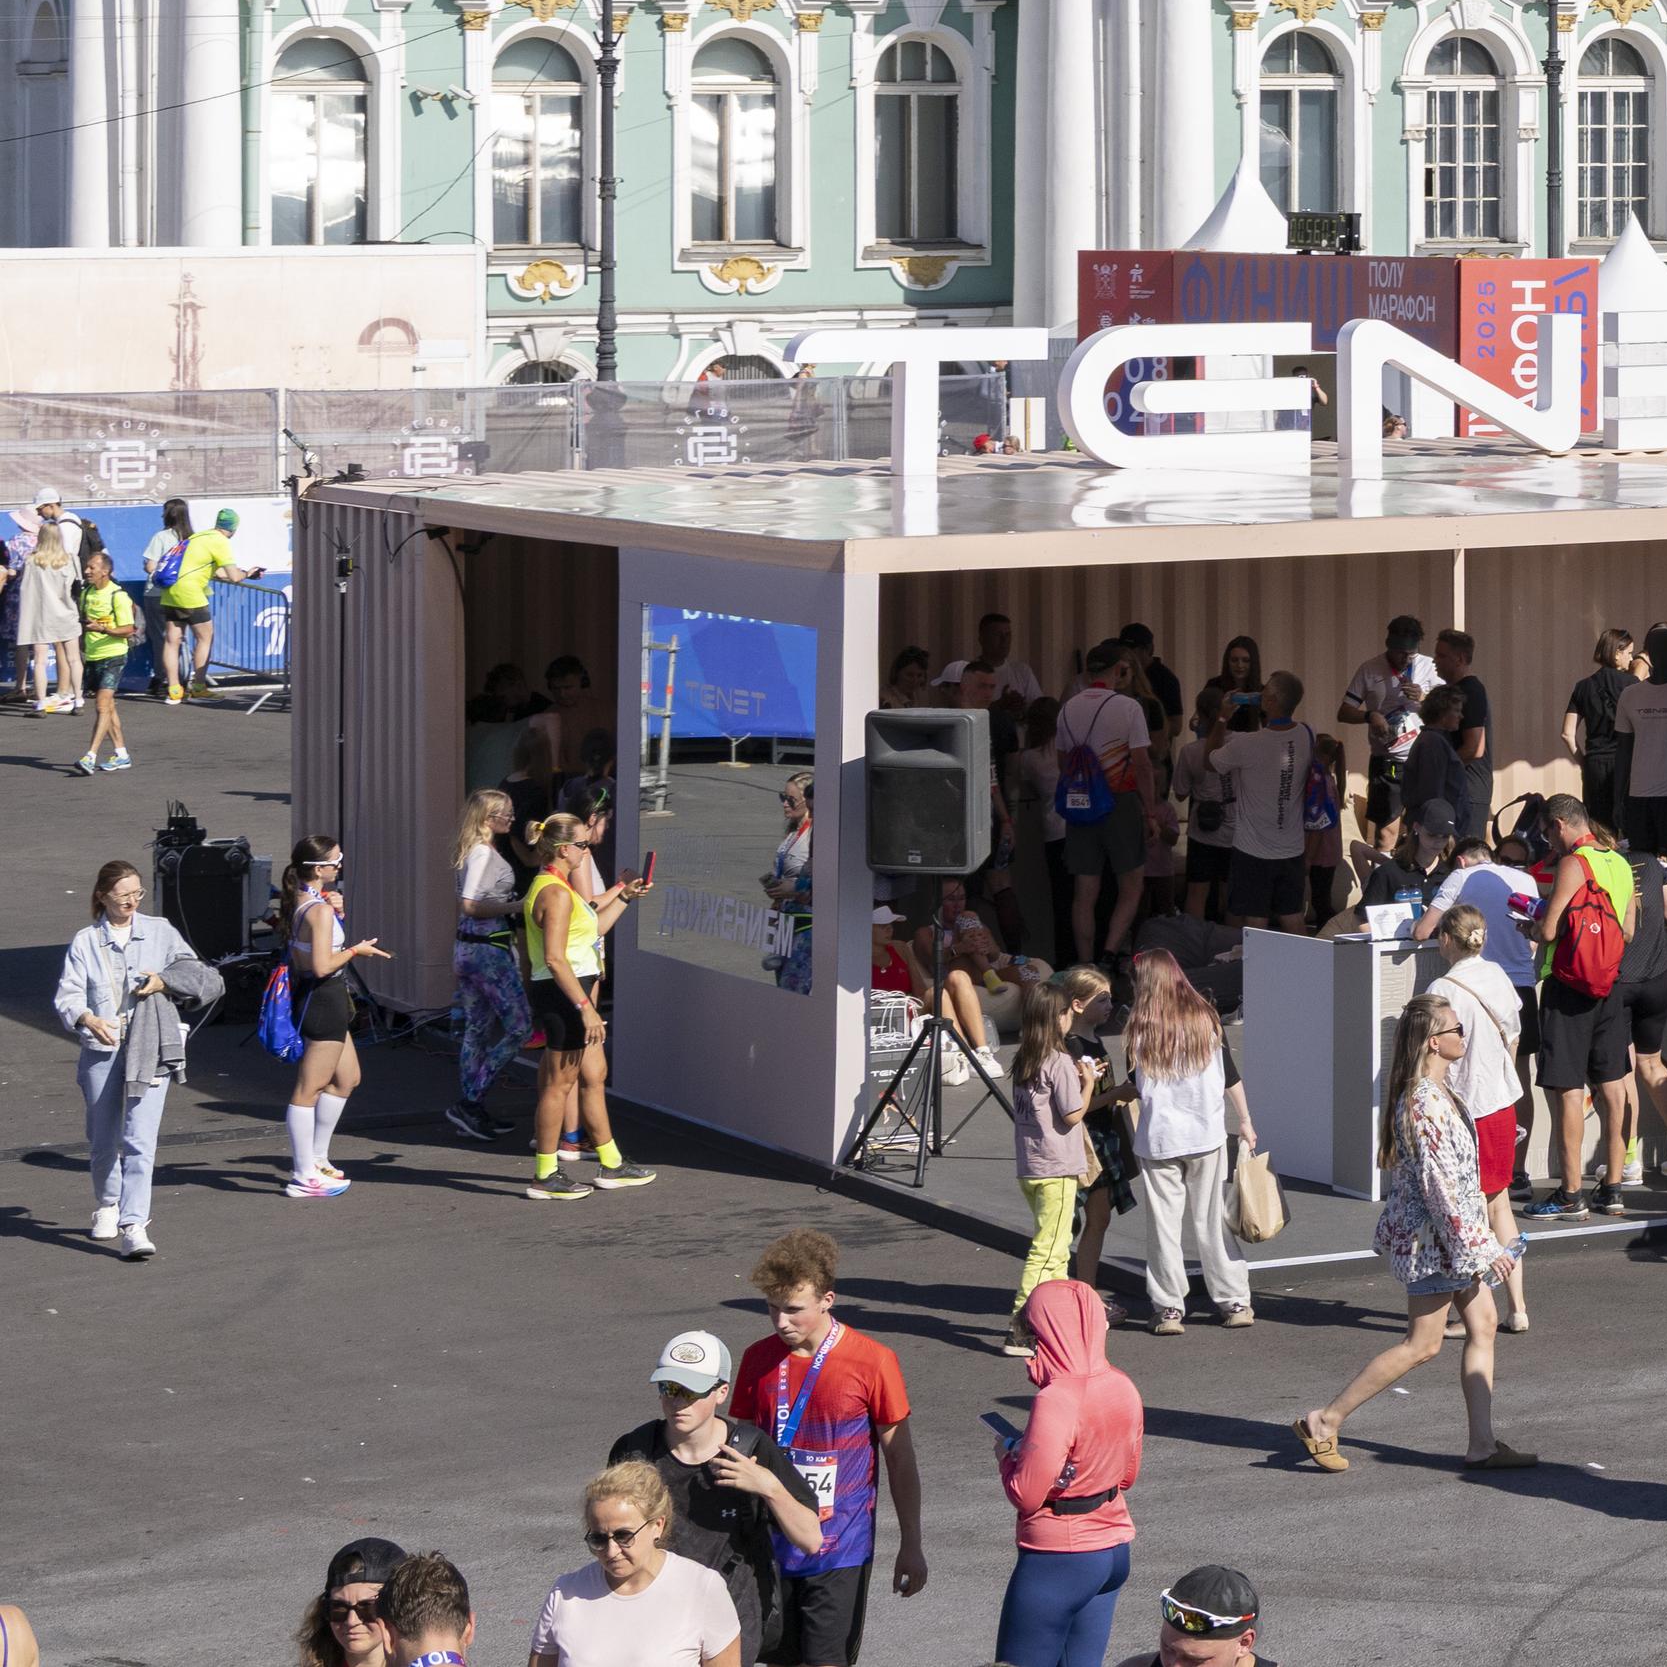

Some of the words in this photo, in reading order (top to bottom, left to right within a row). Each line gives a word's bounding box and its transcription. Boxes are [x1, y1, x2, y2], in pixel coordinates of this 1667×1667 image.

[1368, 260, 1405, 289] ПОЛУ
[1368, 292, 1437, 323] МАРАФОН
[1477, 280, 1495, 359] 2025
